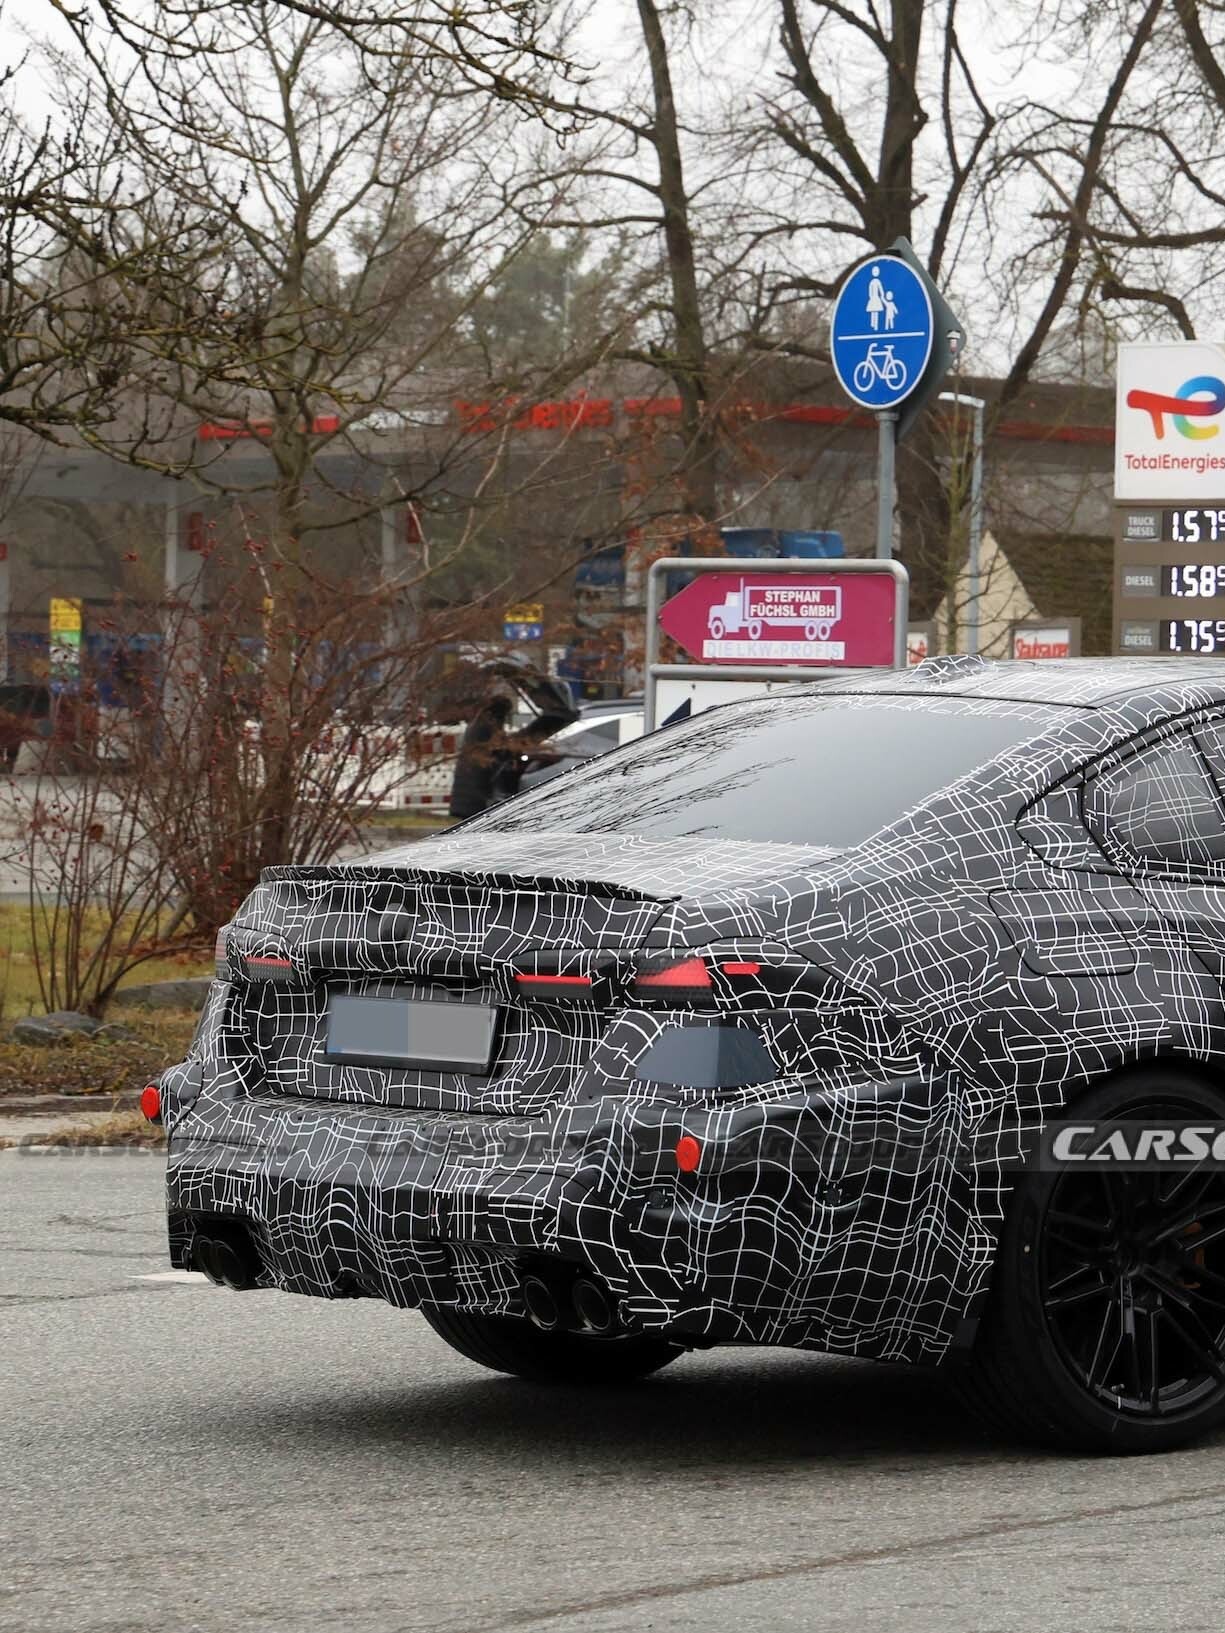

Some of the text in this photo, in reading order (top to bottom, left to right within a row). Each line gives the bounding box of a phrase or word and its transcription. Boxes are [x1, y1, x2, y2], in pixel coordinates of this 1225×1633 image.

[1128, 516, 1155, 526] TRUCK
[1127, 527, 1155, 536] DIESEL
[1125, 576, 1154, 586] DIESEL
[764, 591, 820, 603] STEPHAN
[750, 602, 835, 617] FÜCHSL GMBH
[706, 641, 841, 659] DIE LKW-PROFIS
